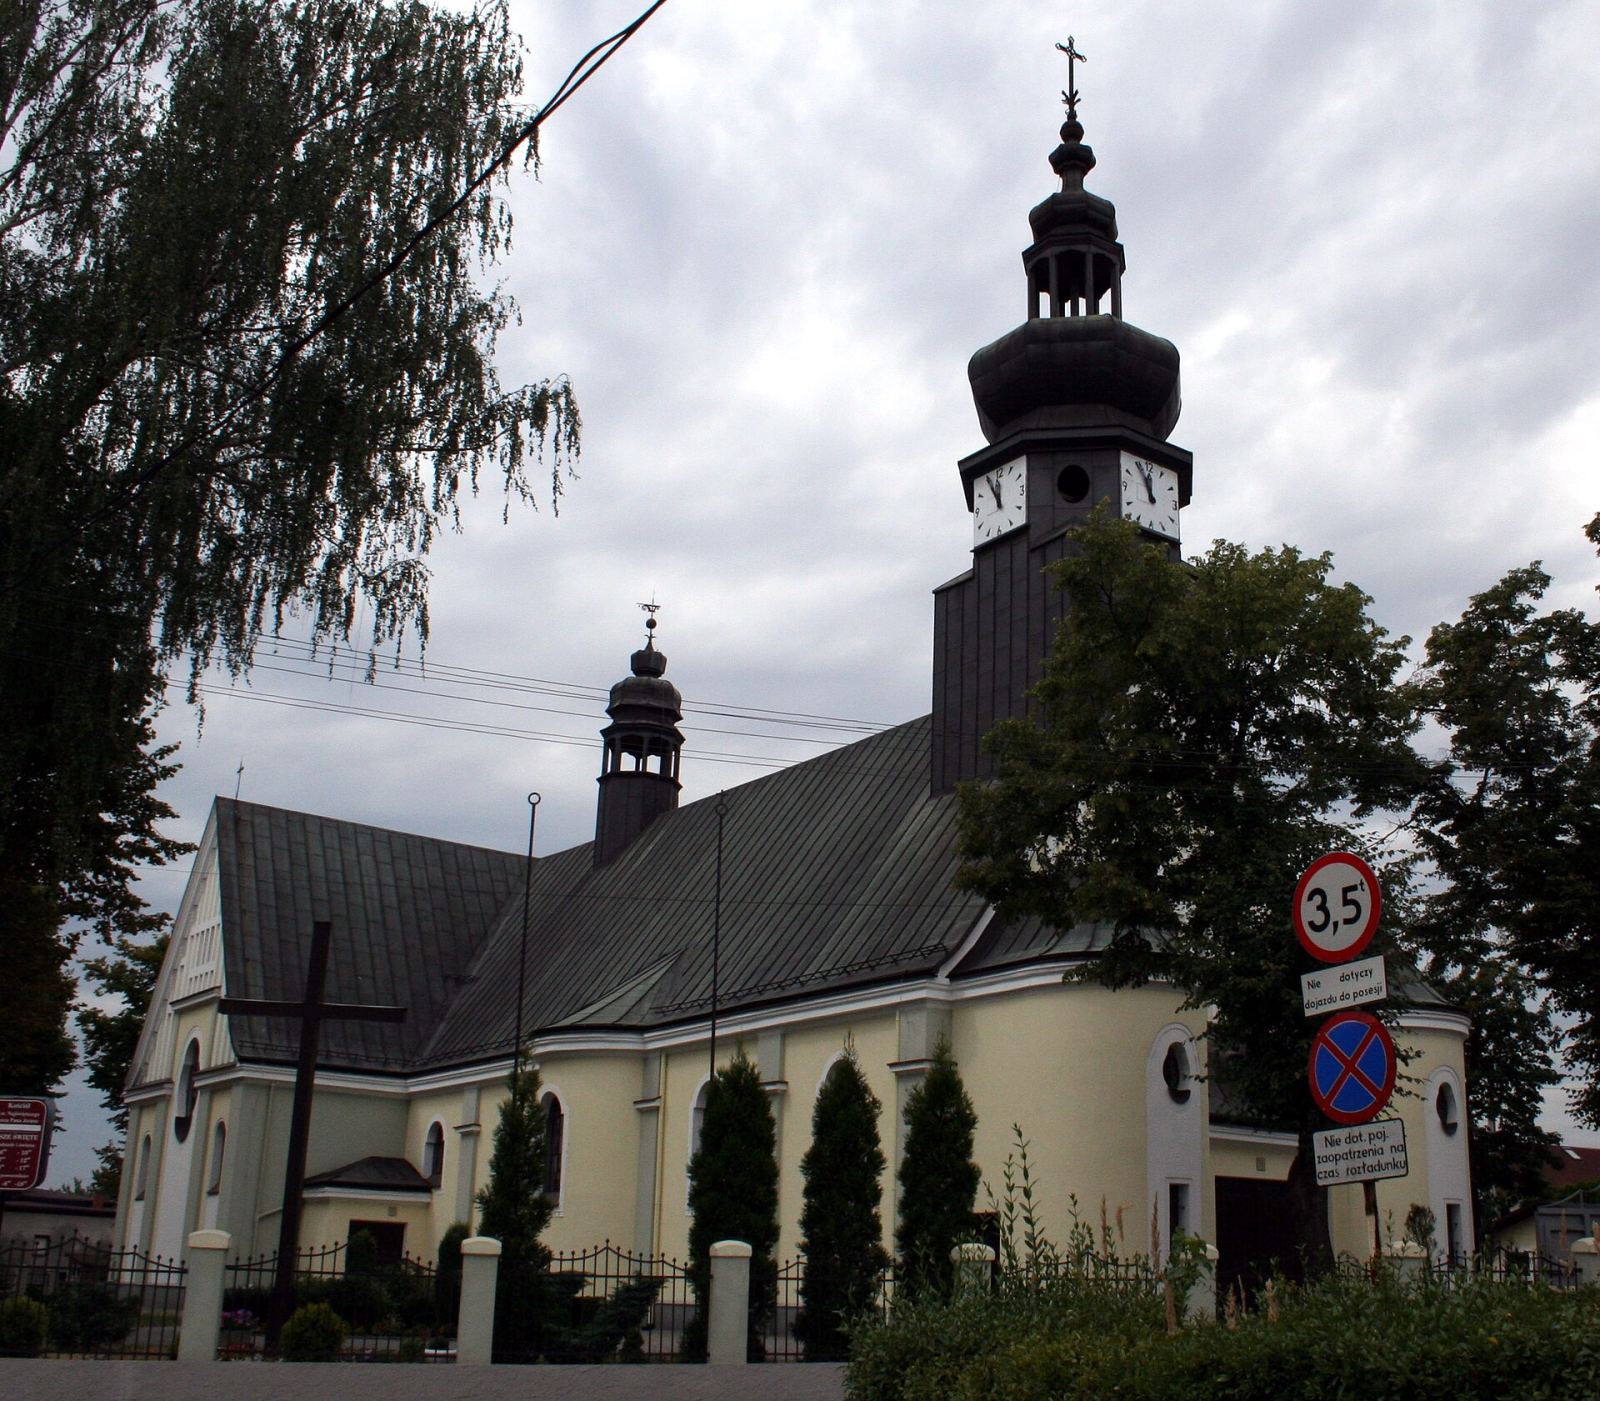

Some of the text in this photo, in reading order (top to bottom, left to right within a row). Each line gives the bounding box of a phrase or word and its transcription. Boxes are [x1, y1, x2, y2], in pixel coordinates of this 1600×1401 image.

[1145, 461, 1153, 473] 12
[996, 468, 1004, 479] 12
[1019, 484, 1025, 496] 3
[1122, 480, 1128, 491] 9
[1172, 500, 1177, 511] 3
[975, 507, 980, 518] 9
[1306, 967, 1374, 990] Nie dotyczy
[1304, 982, 1383, 1010] dojazdu do posesji
[1324, 1126, 1389, 1148] Nie dot. poj.
[1316, 1144, 1404, 1165] zaopatrzenia na
[1317, 1158, 1406, 1180] czas rozładunku
